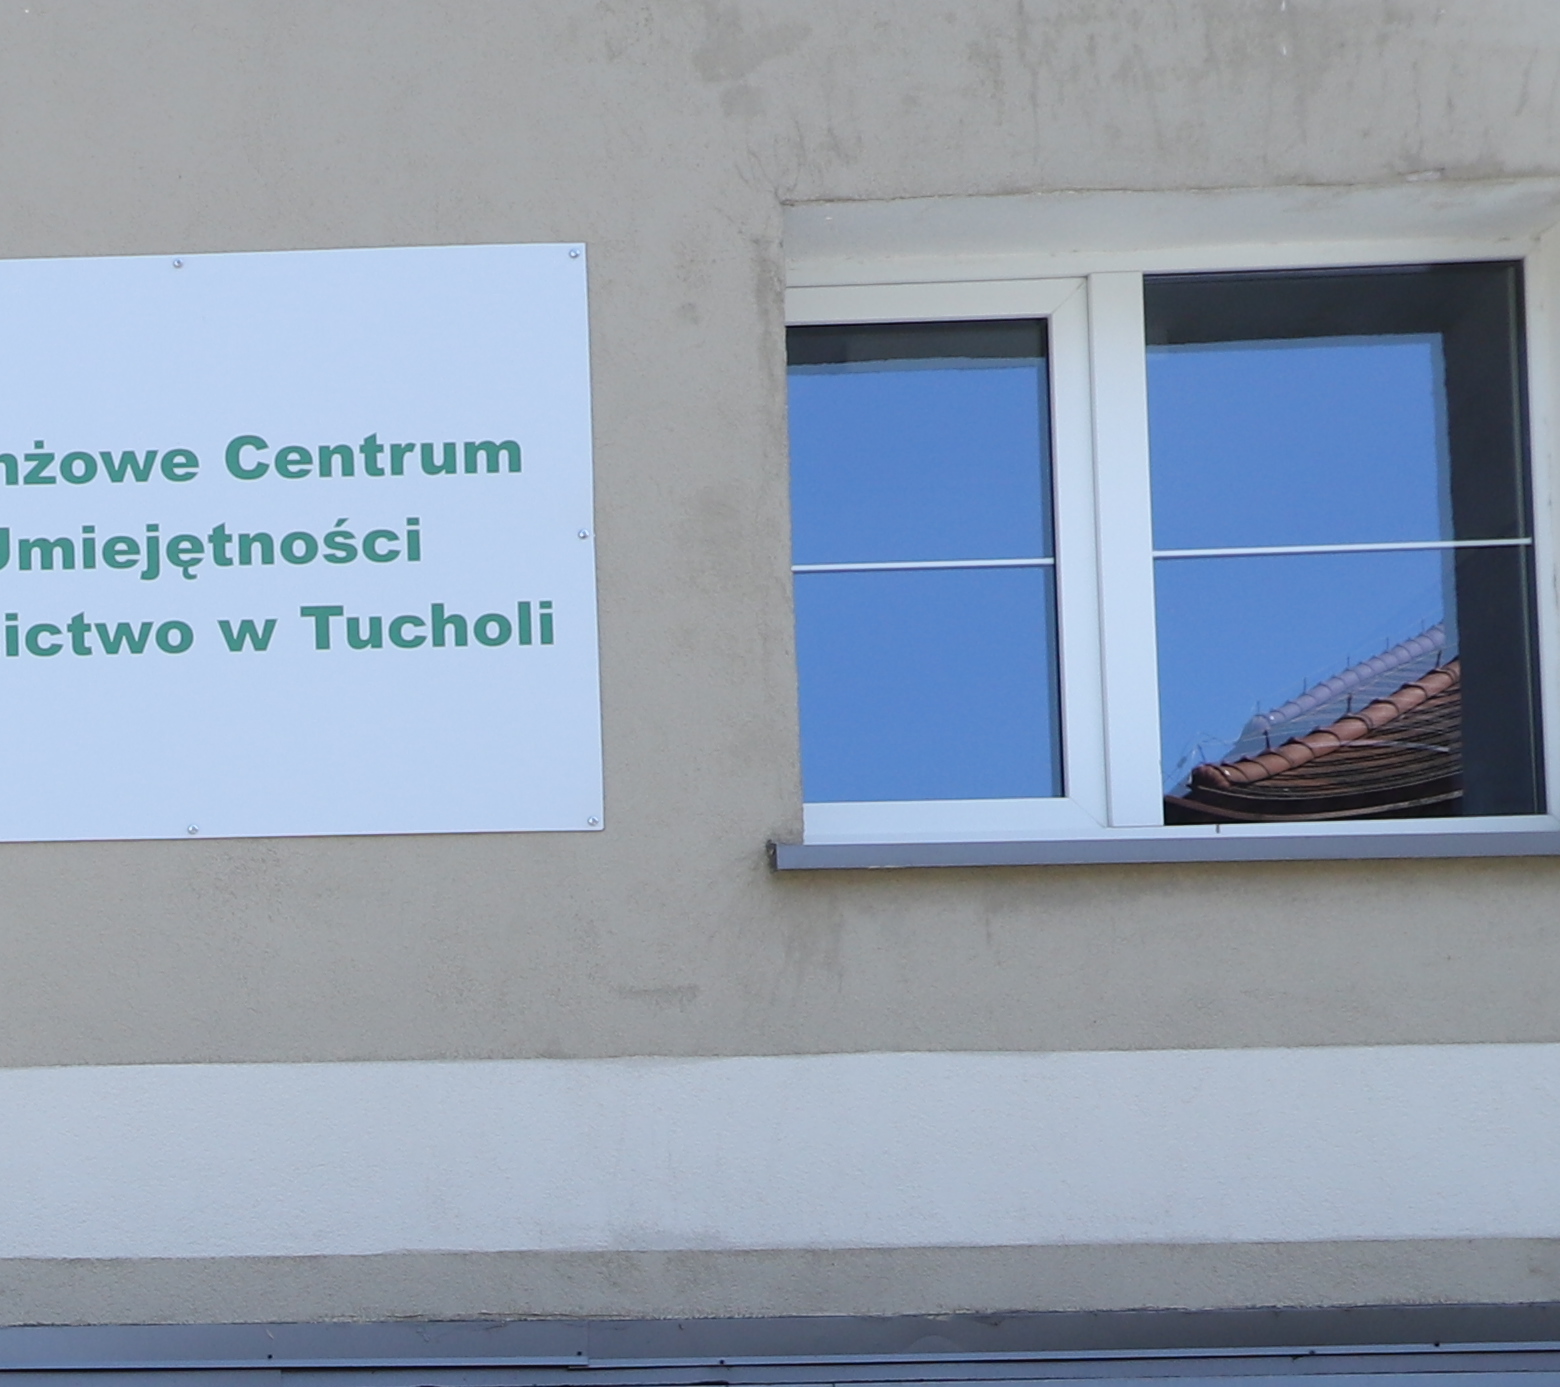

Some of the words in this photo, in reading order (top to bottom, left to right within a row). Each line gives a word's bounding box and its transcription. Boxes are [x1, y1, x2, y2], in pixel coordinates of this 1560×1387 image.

[226, 434, 521, 479] Centrum
[219, 619, 276, 651] w
[301, 601, 553, 649] Tucholi
